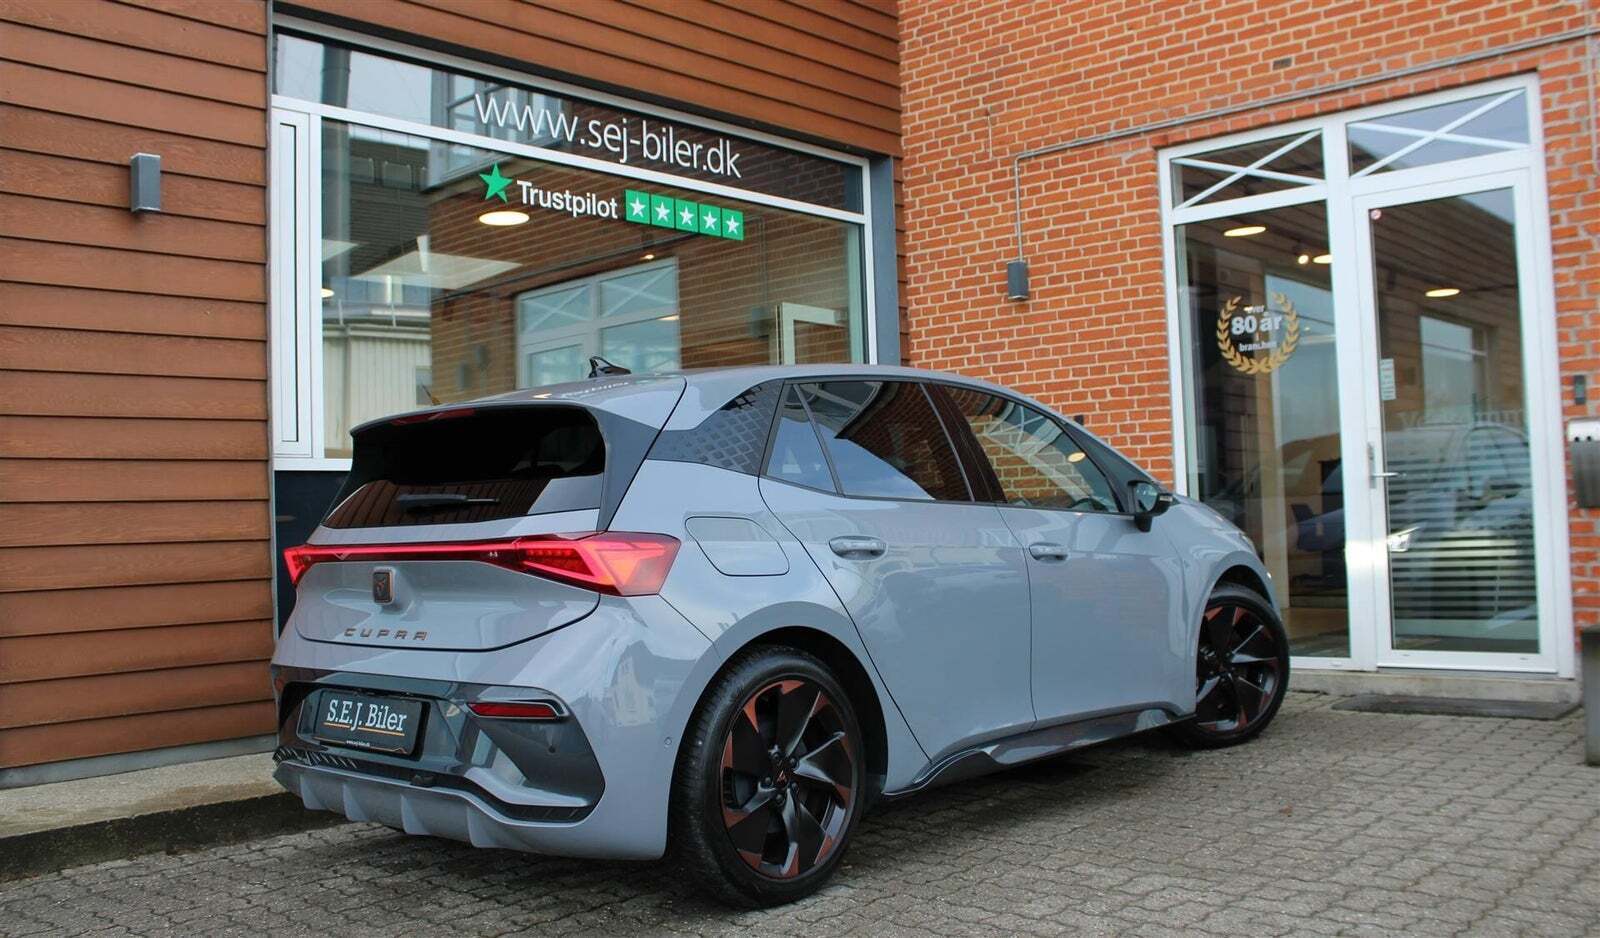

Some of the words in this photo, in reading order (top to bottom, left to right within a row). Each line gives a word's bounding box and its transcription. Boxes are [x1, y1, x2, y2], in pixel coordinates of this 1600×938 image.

[475, 93, 742, 179] www.sej-biler.dk
[516, 180, 618, 219] Trustpilot
[1231, 315, 1256, 335] 80
[1260, 312, 1282, 332] år
[344, 627, 427, 641] CUPRA
[326, 699, 363, 731] S.E.J.
[365, 703, 408, 731] Biler
